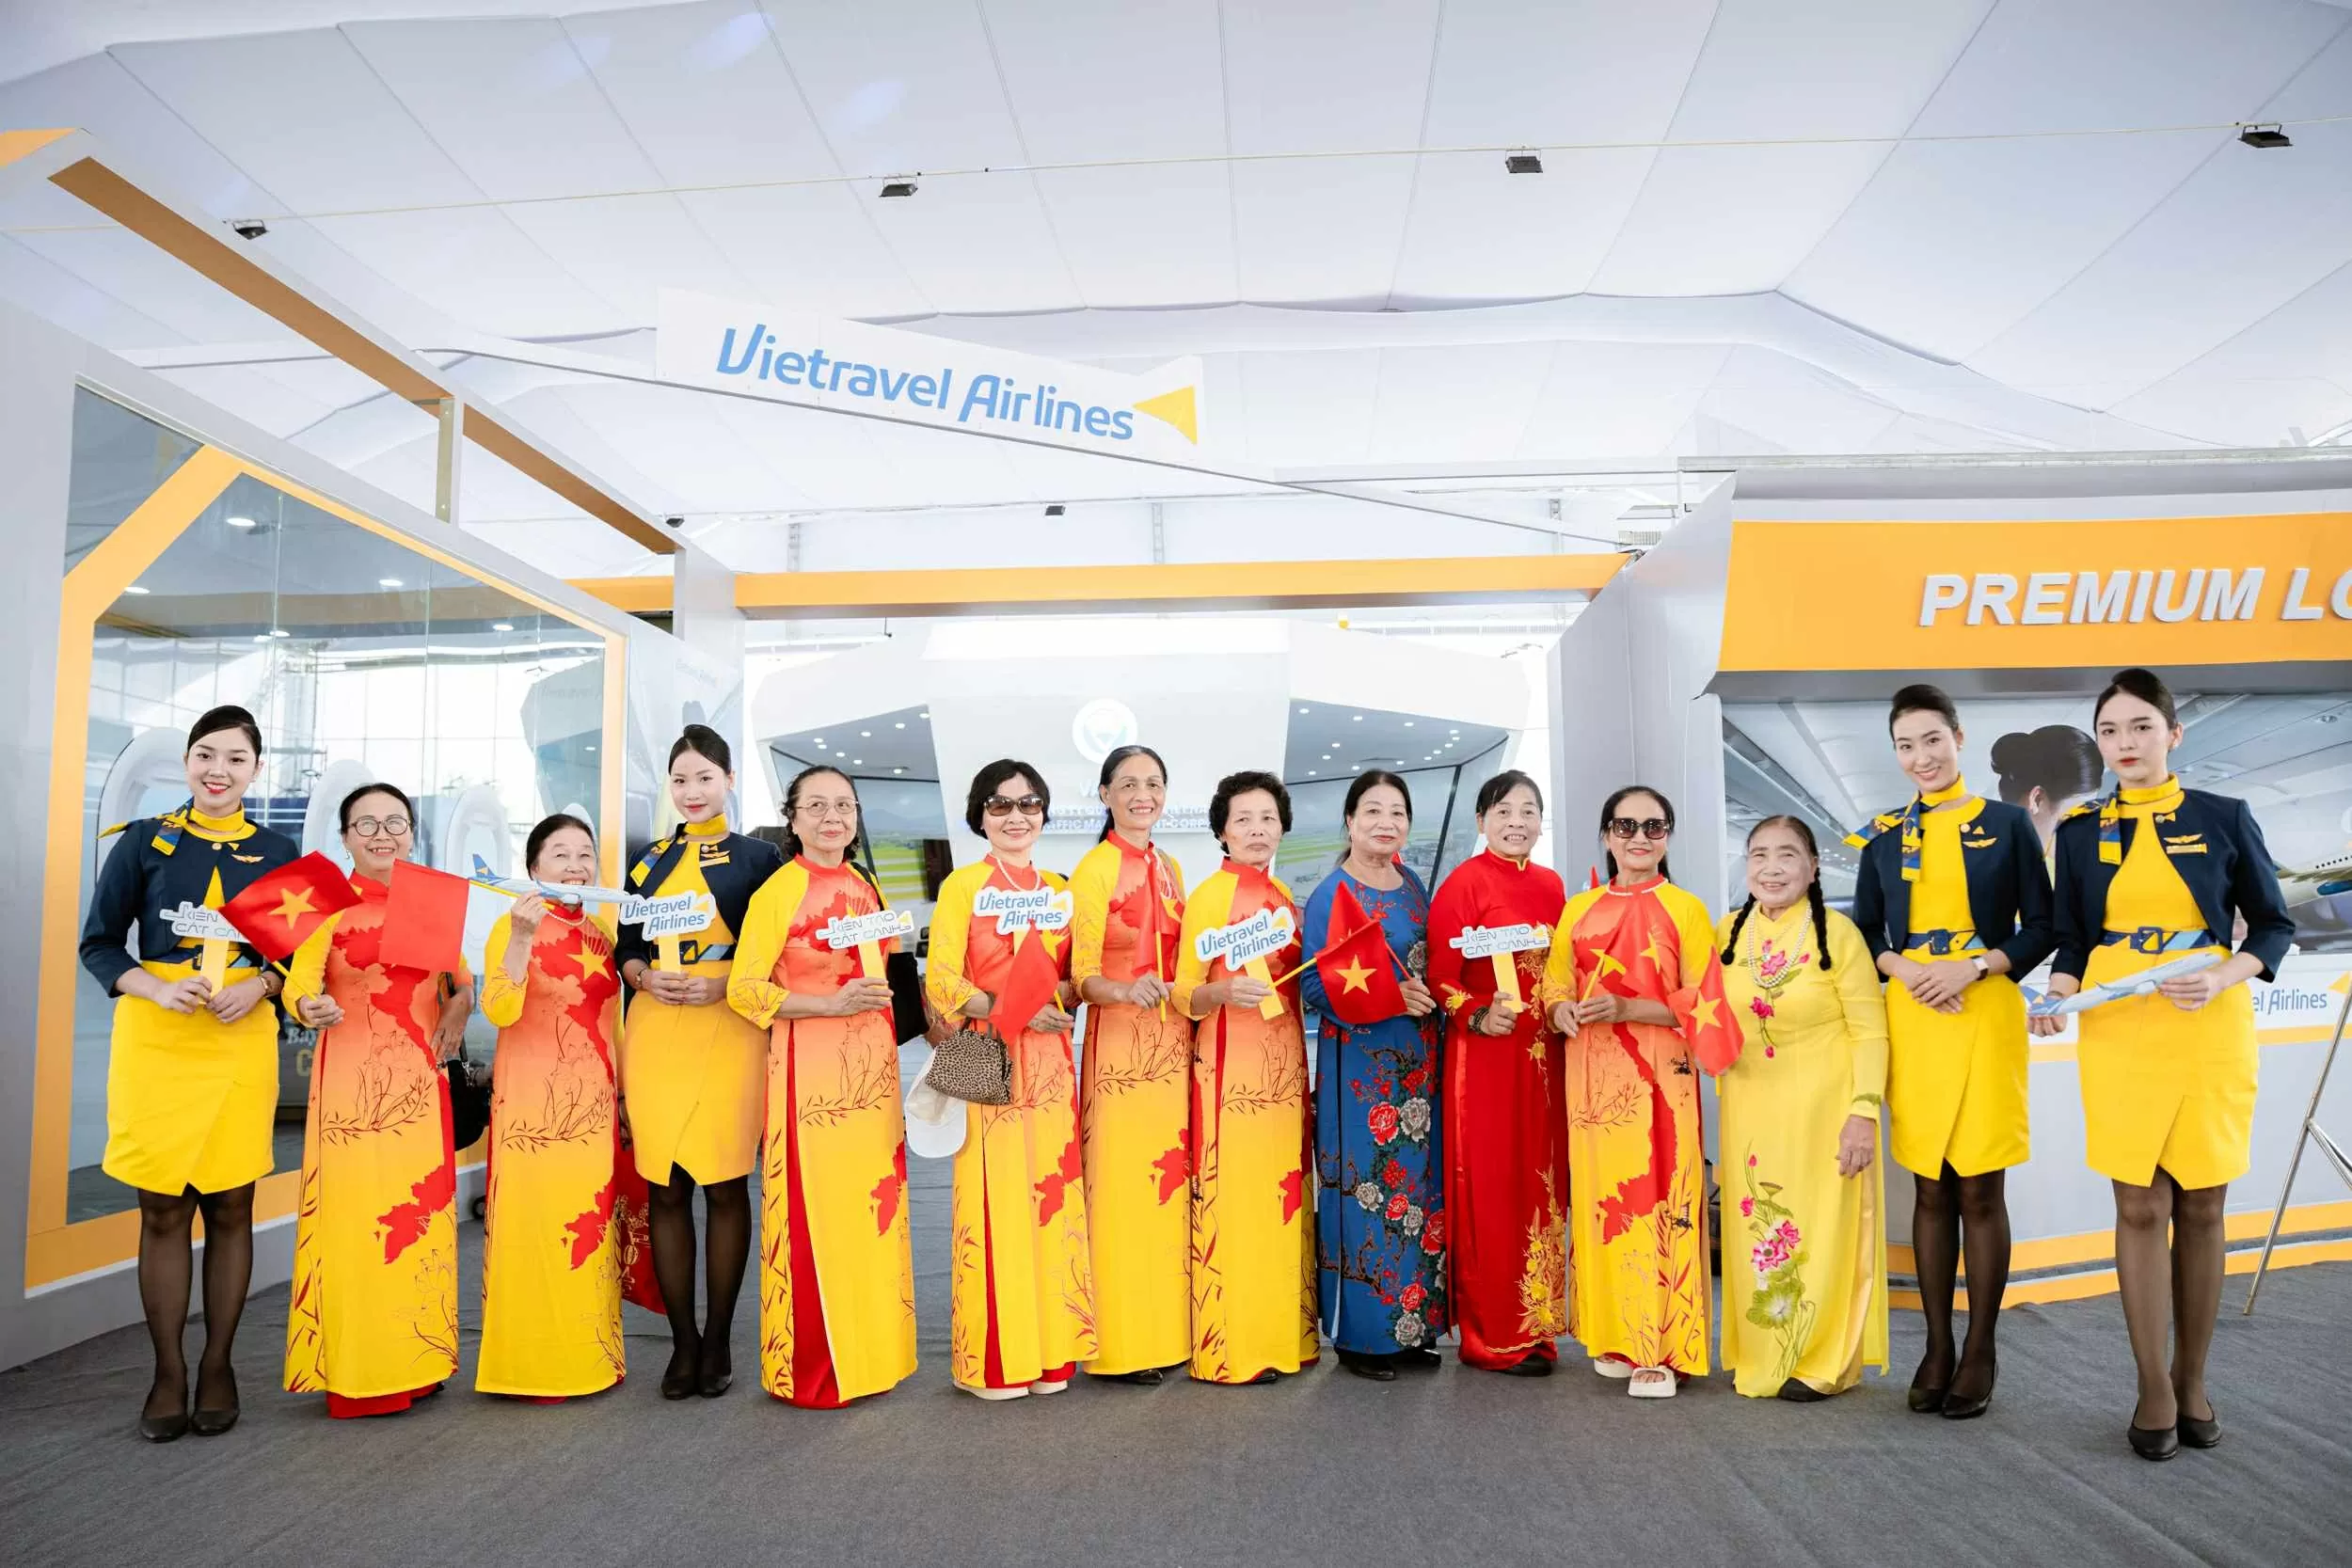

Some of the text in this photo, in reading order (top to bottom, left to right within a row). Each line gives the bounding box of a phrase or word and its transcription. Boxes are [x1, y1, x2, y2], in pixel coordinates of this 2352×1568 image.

[716, 323, 1134, 440] Vietravel Airlines
[1919, 567, 2266, 627] PREMIUM
[625, 895, 691, 919] Vietravel
[979, 892, 1049, 911] Vietravel
[647, 913, 706, 935] Airlines
[1002, 910, 1062, 929] Airlines
[1200, 914, 1268, 956] Vietravel
[1232, 928, 1287, 965] Airlines
[2266, 987, 2328, 1016] Airlines
